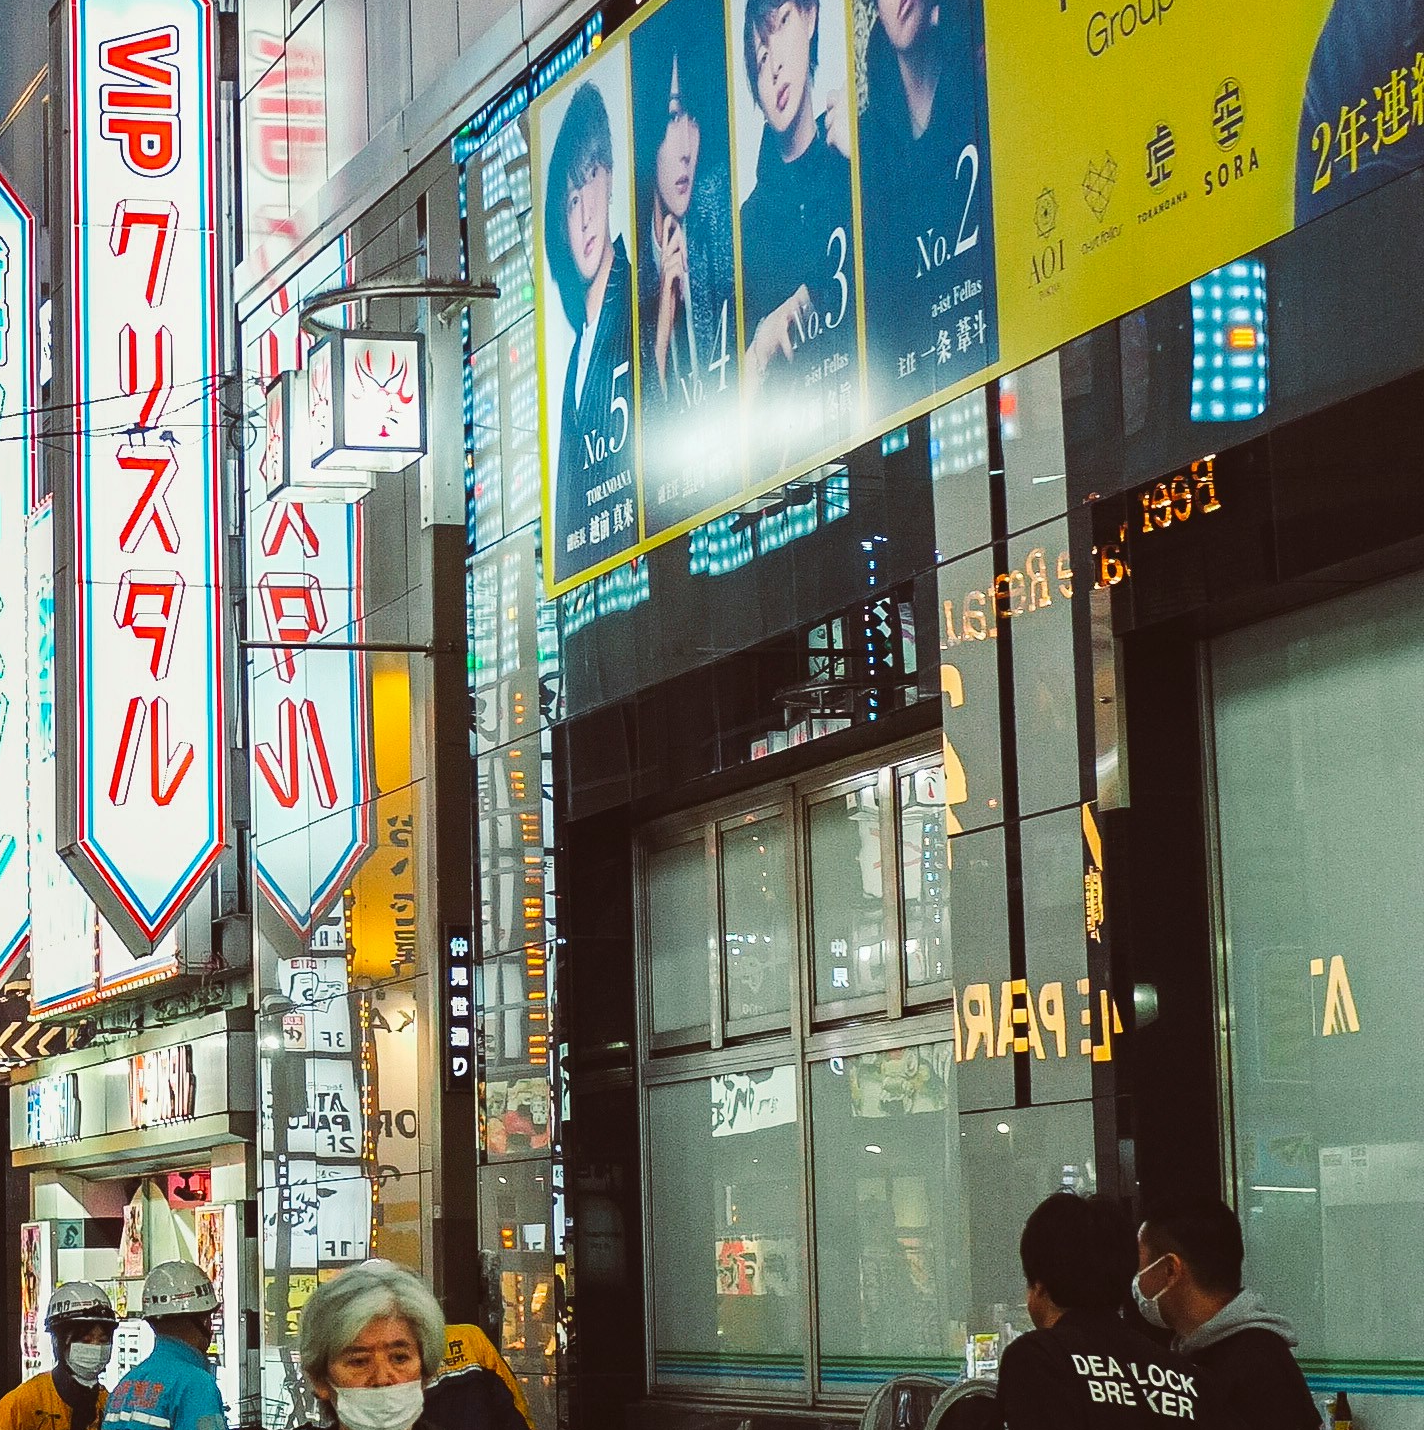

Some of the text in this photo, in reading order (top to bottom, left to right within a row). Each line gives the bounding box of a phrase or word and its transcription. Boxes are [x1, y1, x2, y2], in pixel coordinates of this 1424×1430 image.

[1203, 147, 1260, 197] SORA
[916, 144, 979, 278] No.2
[1029, 239, 1066, 289] AOI
[953, 277, 983, 306] Fellas
[582, 361, 629, 470] No.5
[450, 936, 469, 1077] 仲見世通り
[444, 1354, 468, 1367] EPT.
[1071, 1354, 1199, 1398] DEALOCK
[1088, 1379, 1195, 1421] BREKER
